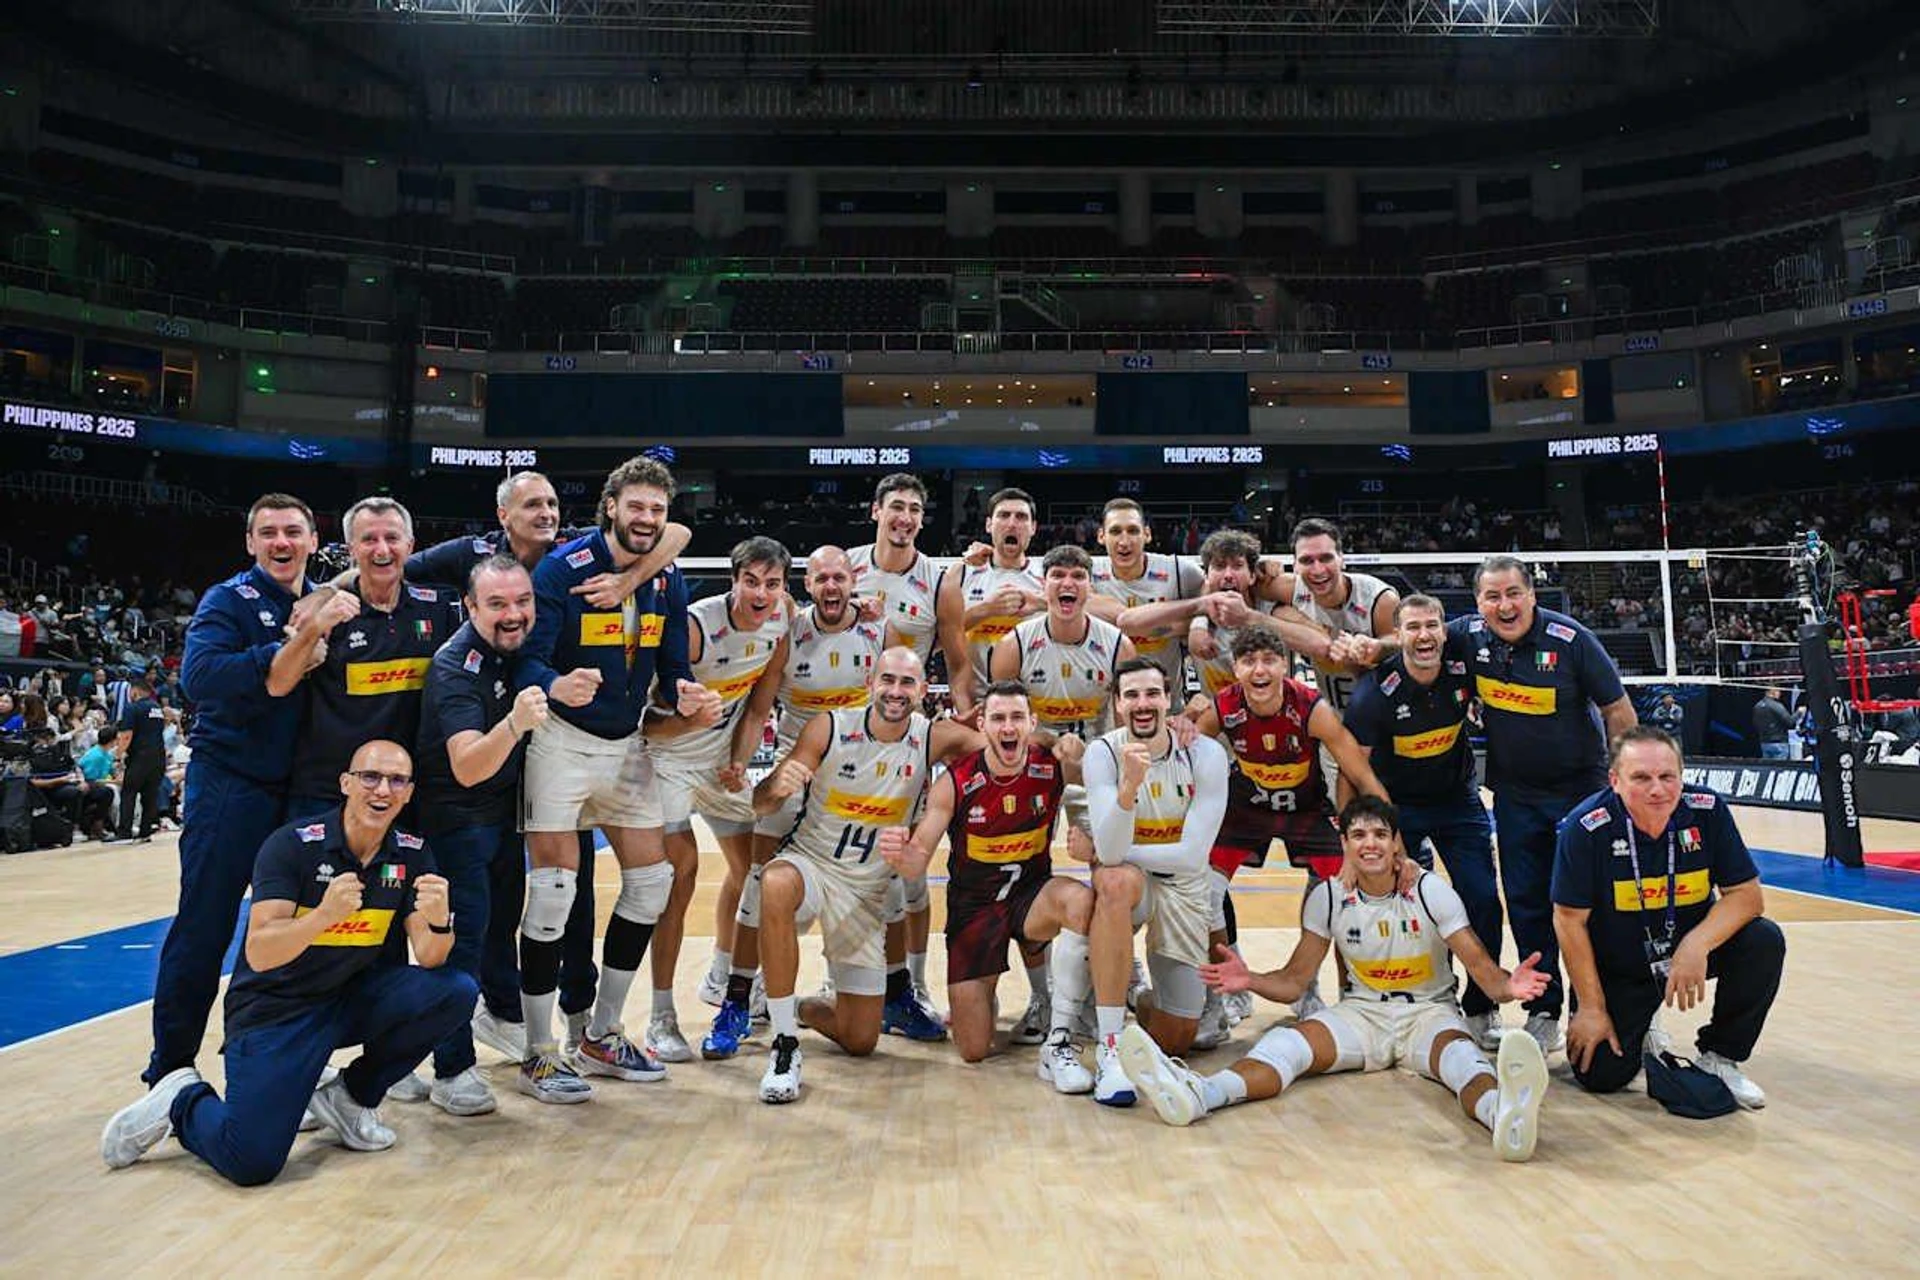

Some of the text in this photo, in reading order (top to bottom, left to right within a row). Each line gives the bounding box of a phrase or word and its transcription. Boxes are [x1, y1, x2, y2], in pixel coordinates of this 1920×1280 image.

[3, 404, 94, 433] PHILIPPINES
[1163, 447, 1230, 464] PHILIPPINES
[1547, 436, 1623, 458] PHILIPPINES
[431, 447, 503, 466] PHILIPPINES
[809, 448, 877, 465] PHILIPPINES
[369, 668, 420, 684] DHL
[1490, 689, 1537, 706] DHL
[1412, 734, 1454, 750] DHL
[1840, 770, 1857, 828] Senoh
[845, 801, 894, 816] DHL
[1136, 825, 1181, 839] DHL
[834, 822, 878, 864] 14
[986, 841, 1034, 854] DHL
[996, 863, 1022, 901] 7
[1367, 966, 1416, 980] DHL
